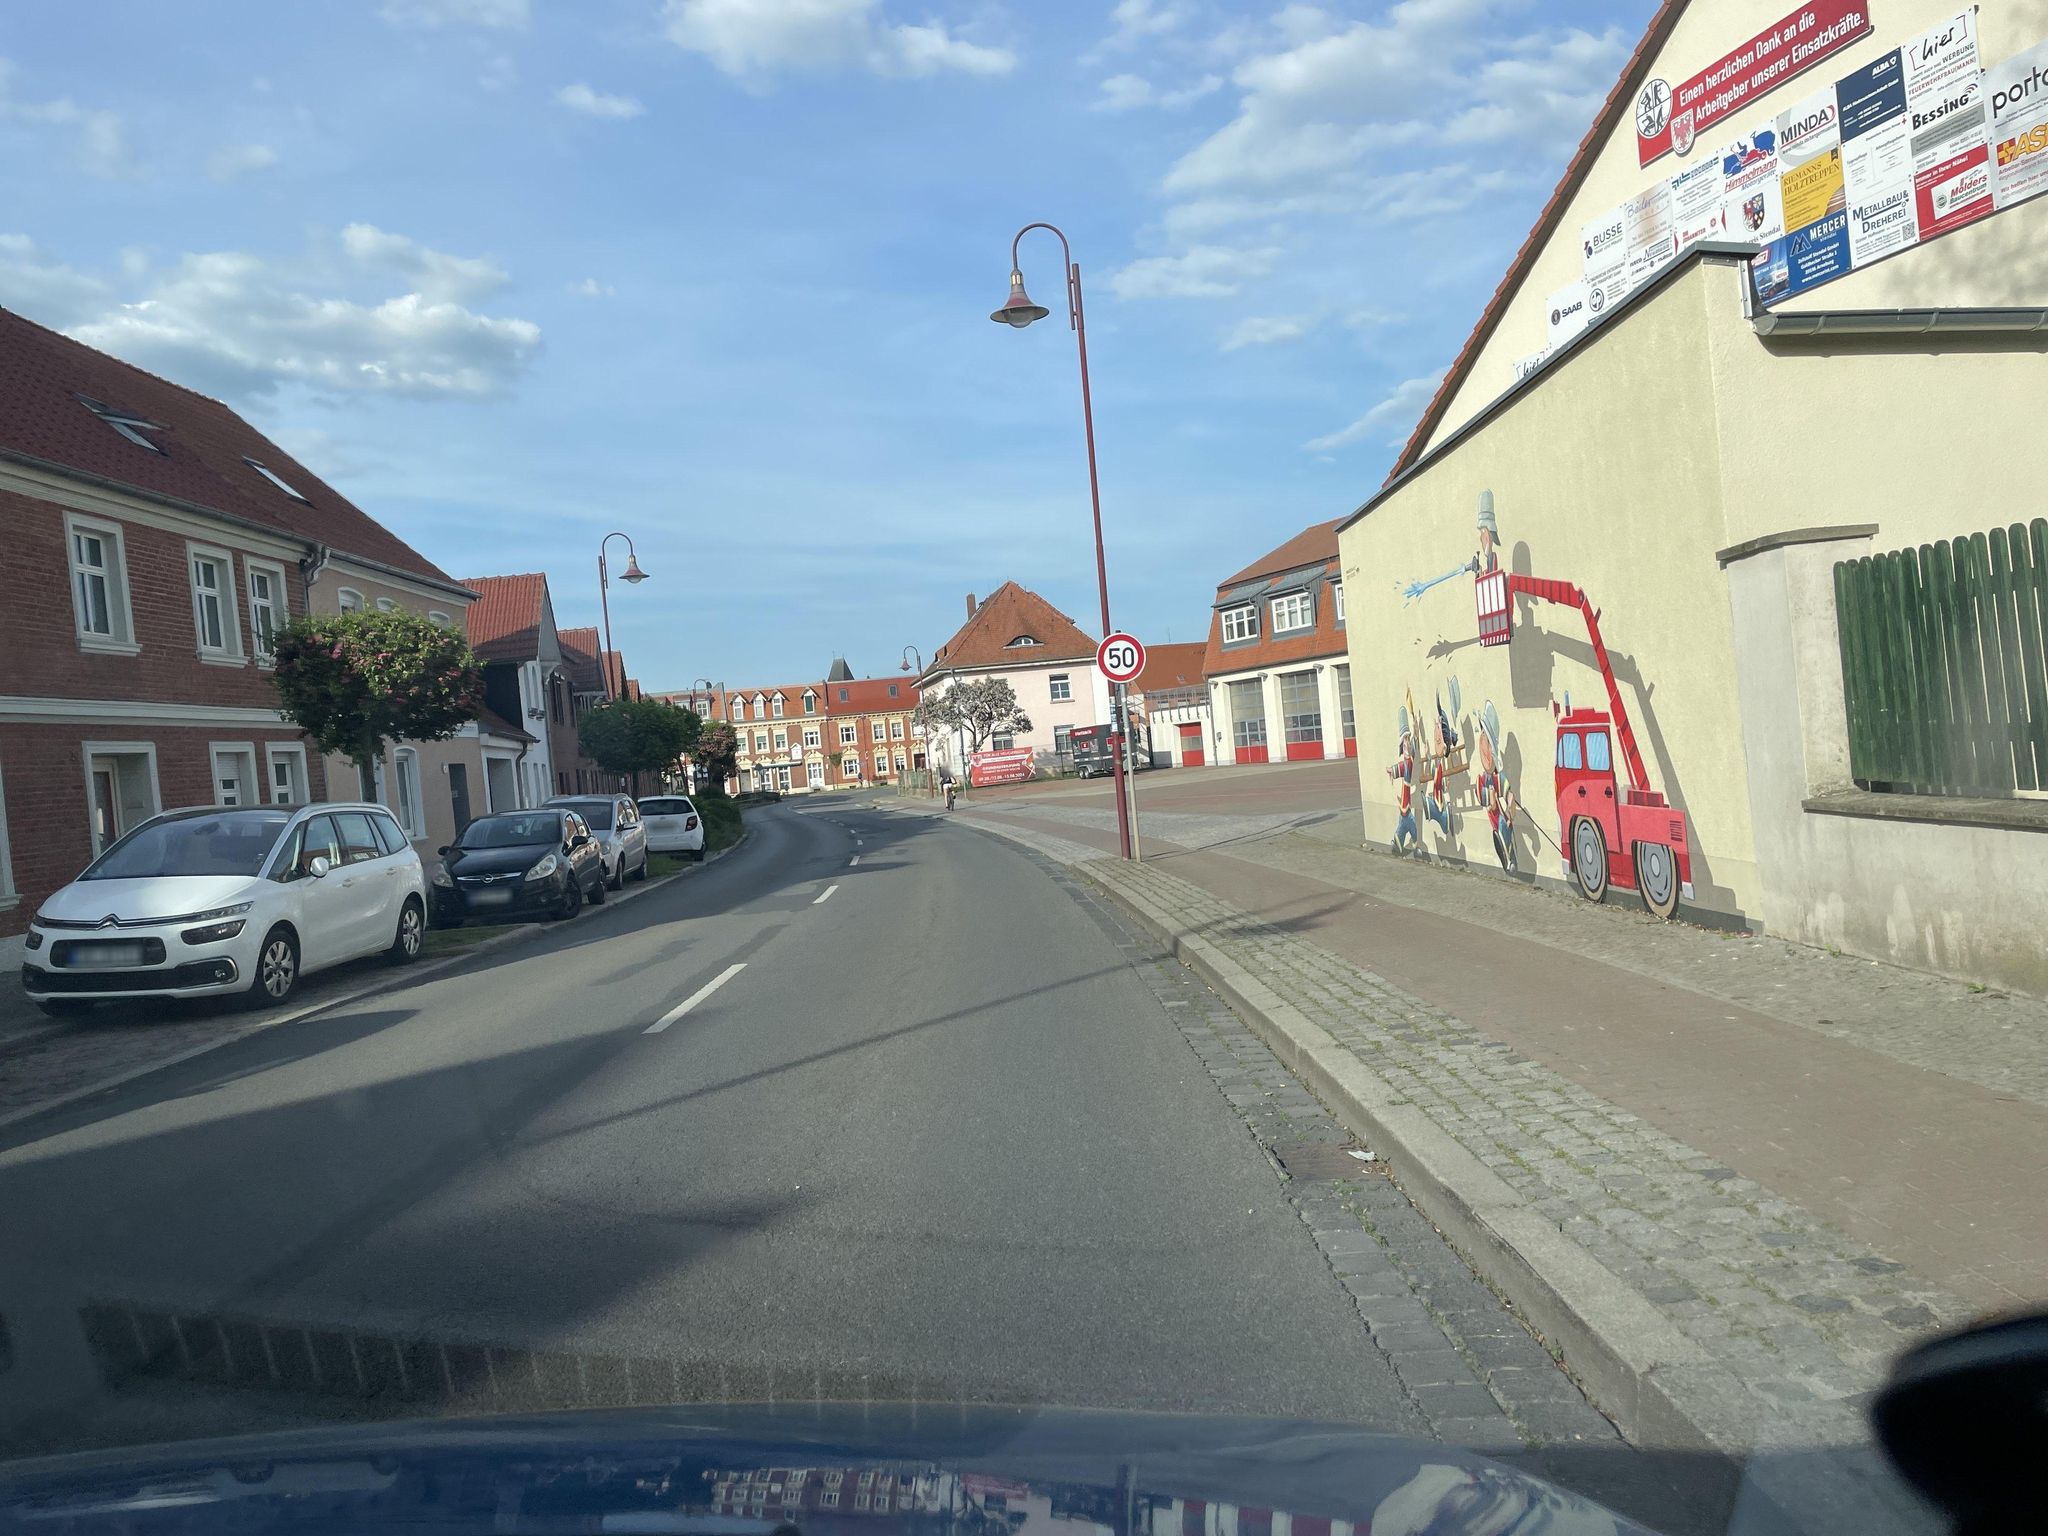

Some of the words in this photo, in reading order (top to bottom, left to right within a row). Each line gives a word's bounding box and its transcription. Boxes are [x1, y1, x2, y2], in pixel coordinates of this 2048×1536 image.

[1680, 86, 1704, 107] Einen
[1706, 51, 1755, 90] herzlichen
[1756, 34, 1782, 60] Dank
[1783, 26, 1797, 41] an
[1799, 11, 1815, 33] die
[1922, 27, 1954, 61] hier
[1942, 42, 1974, 63] WERBUNG
[1696, 85, 1749, 122] Arbeitgeber
[1751, 55, 1790, 88] unserer
[1792, 12, 1865, 65] Einsatzkräfte.
[1872, 60, 1890, 76] ALBA
[1908, 56, 1977, 95] FEUERWEHRFRAU(MANN)
[1780, 108, 1829, 145] MINDA
[1912, 94, 1970, 130] BESSING
[2010, 122, 2048, 160] AS
[1725, 158, 1778, 190] Himmelmann
[1783, 161, 1822, 186] RIEMANNS
[1784, 162, 1840, 196] HOLZTREPPEN
[1593, 222, 1623, 247] BUSSE
[1810, 214, 1846, 241] MERCER
[1862, 207, 1906, 233] DREHEREI
[1561, 301, 1582, 318] SAAB
[1108, 646, 1134, 669] 50
